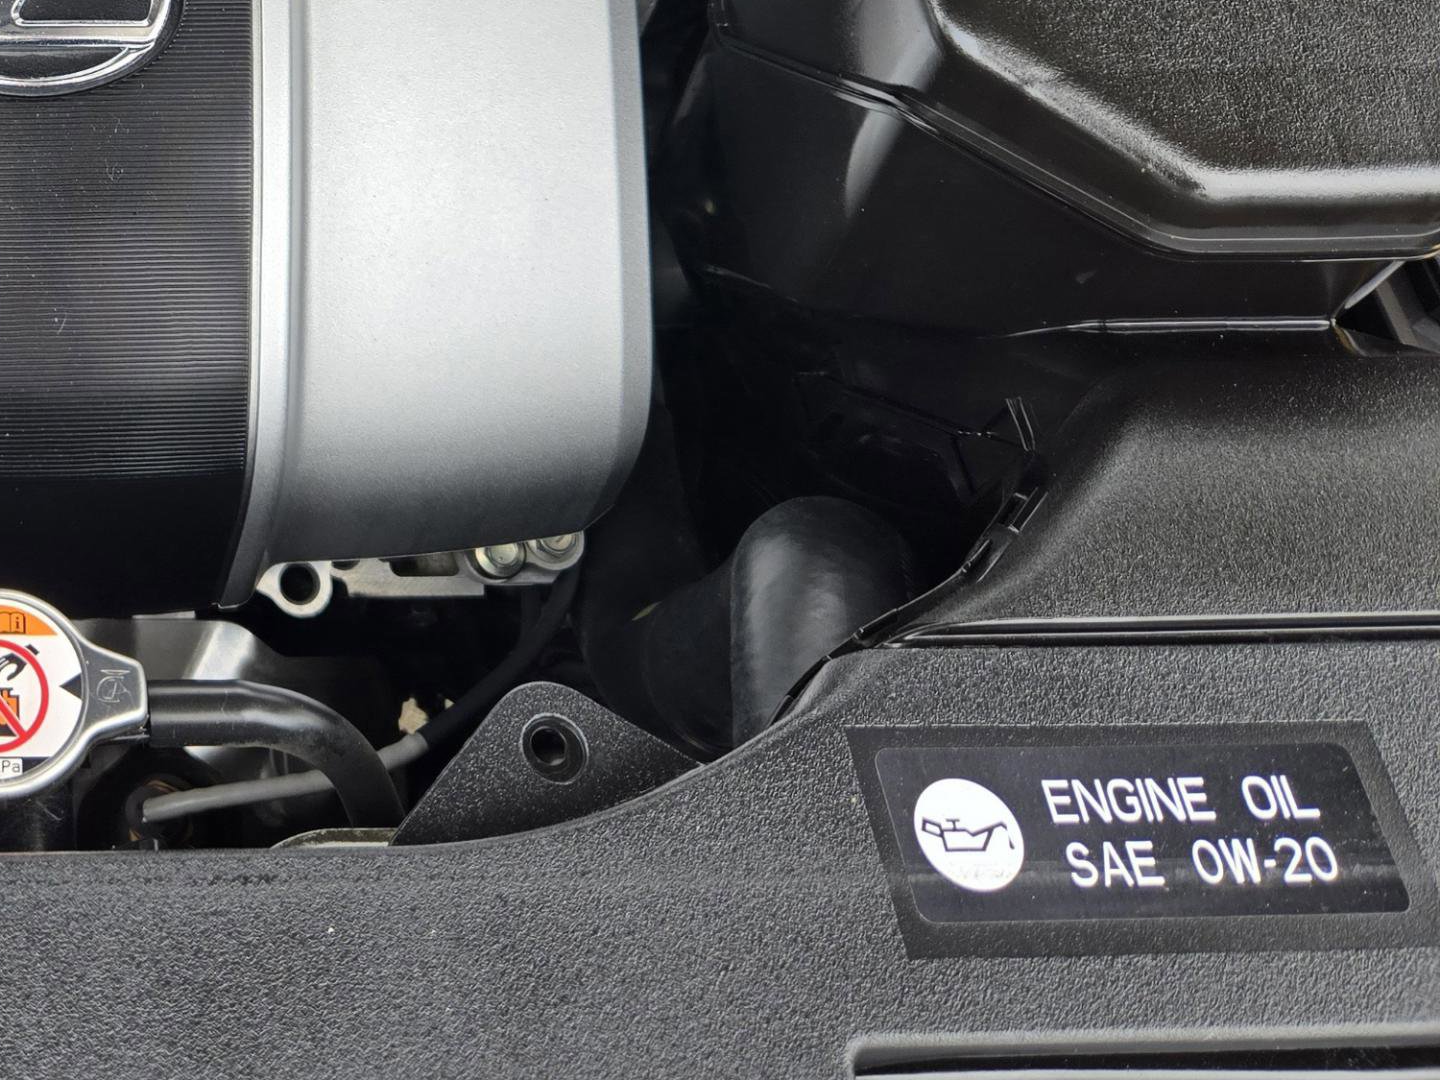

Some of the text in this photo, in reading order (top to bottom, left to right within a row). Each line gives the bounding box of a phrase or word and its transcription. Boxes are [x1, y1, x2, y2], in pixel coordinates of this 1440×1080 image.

[1041, 774, 1321, 824] ENGINE OIL
[1065, 836, 1338, 888] SAE 0W-20
